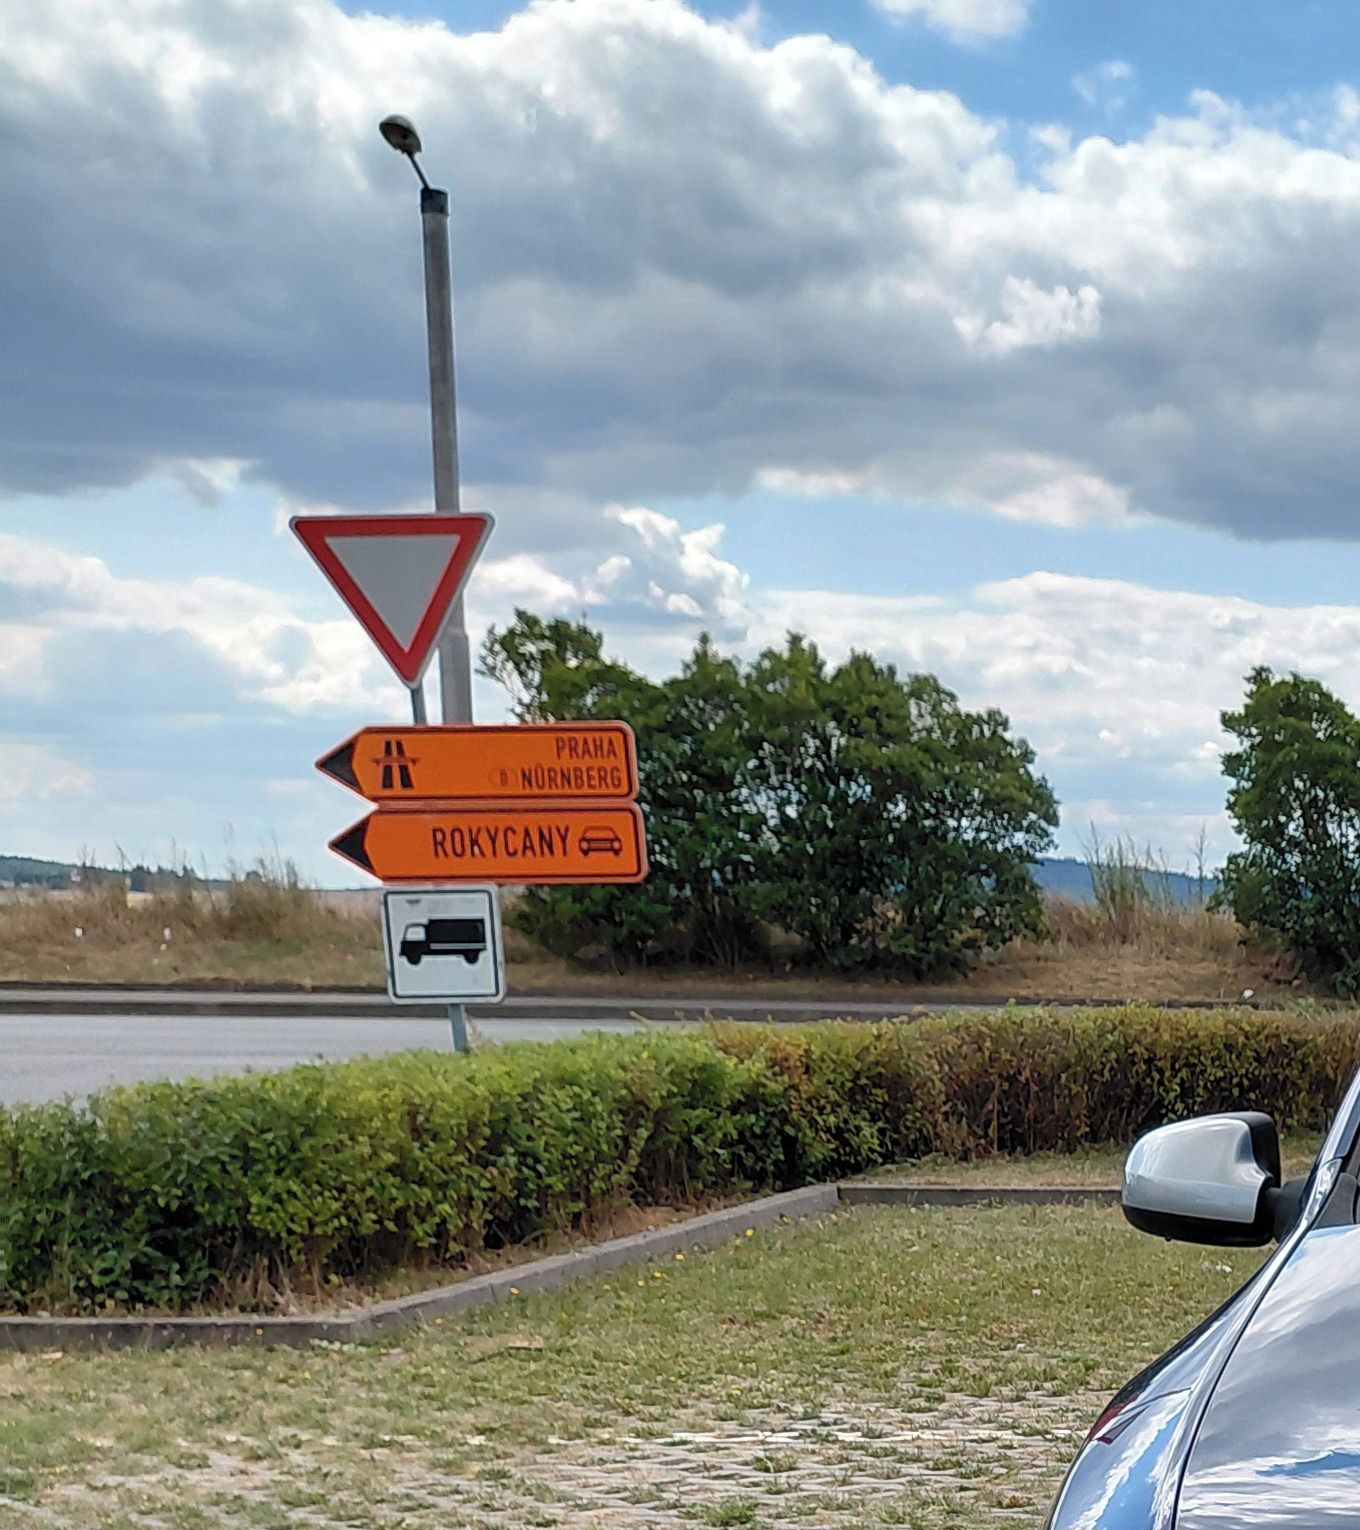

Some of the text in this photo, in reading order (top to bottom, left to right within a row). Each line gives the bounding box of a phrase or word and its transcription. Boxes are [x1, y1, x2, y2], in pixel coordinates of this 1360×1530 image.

[555, 736, 618, 760] PRAHA
[520, 763, 622, 790] NÜRNBERG
[431, 825, 570, 858] ROKYCANY
